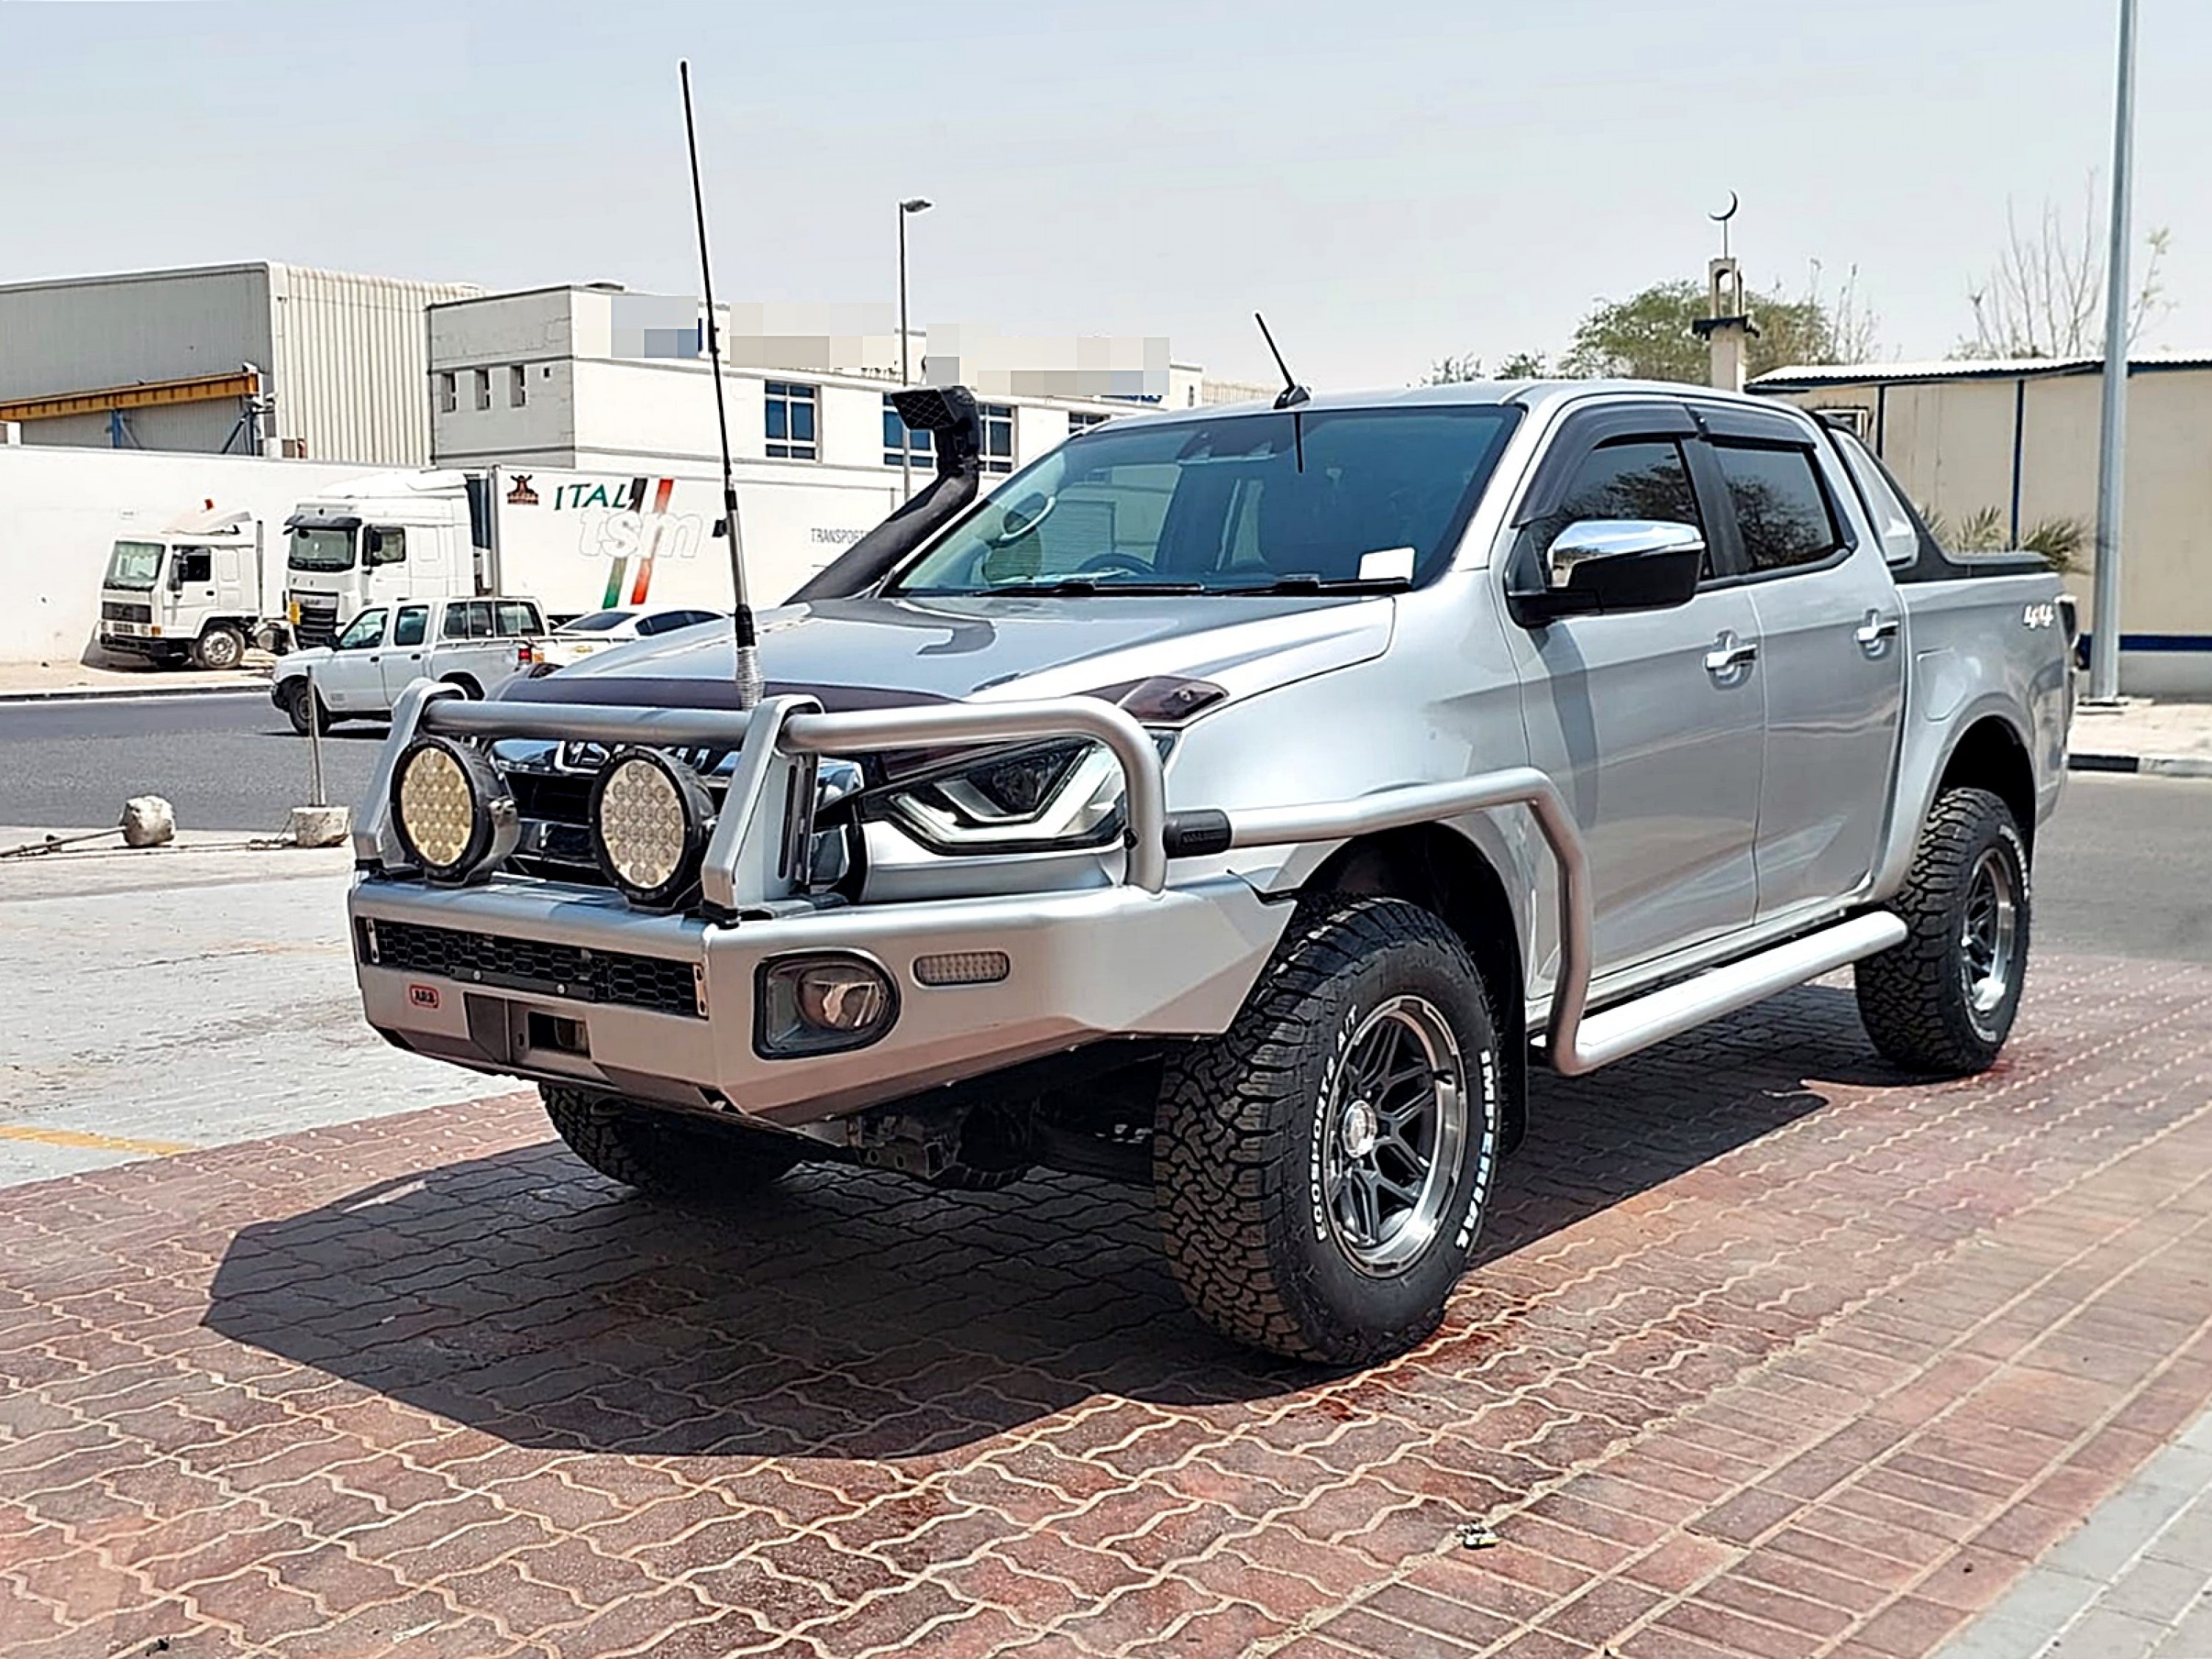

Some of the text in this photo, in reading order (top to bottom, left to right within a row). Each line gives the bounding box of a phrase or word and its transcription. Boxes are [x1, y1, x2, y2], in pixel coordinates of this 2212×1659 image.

[554, 483, 627, 510] ITAL
[579, 508, 703, 559] tsm
[810, 527, 872, 544] TRANSPORT
[1455, 1050, 1495, 1249] IMPERIAL
